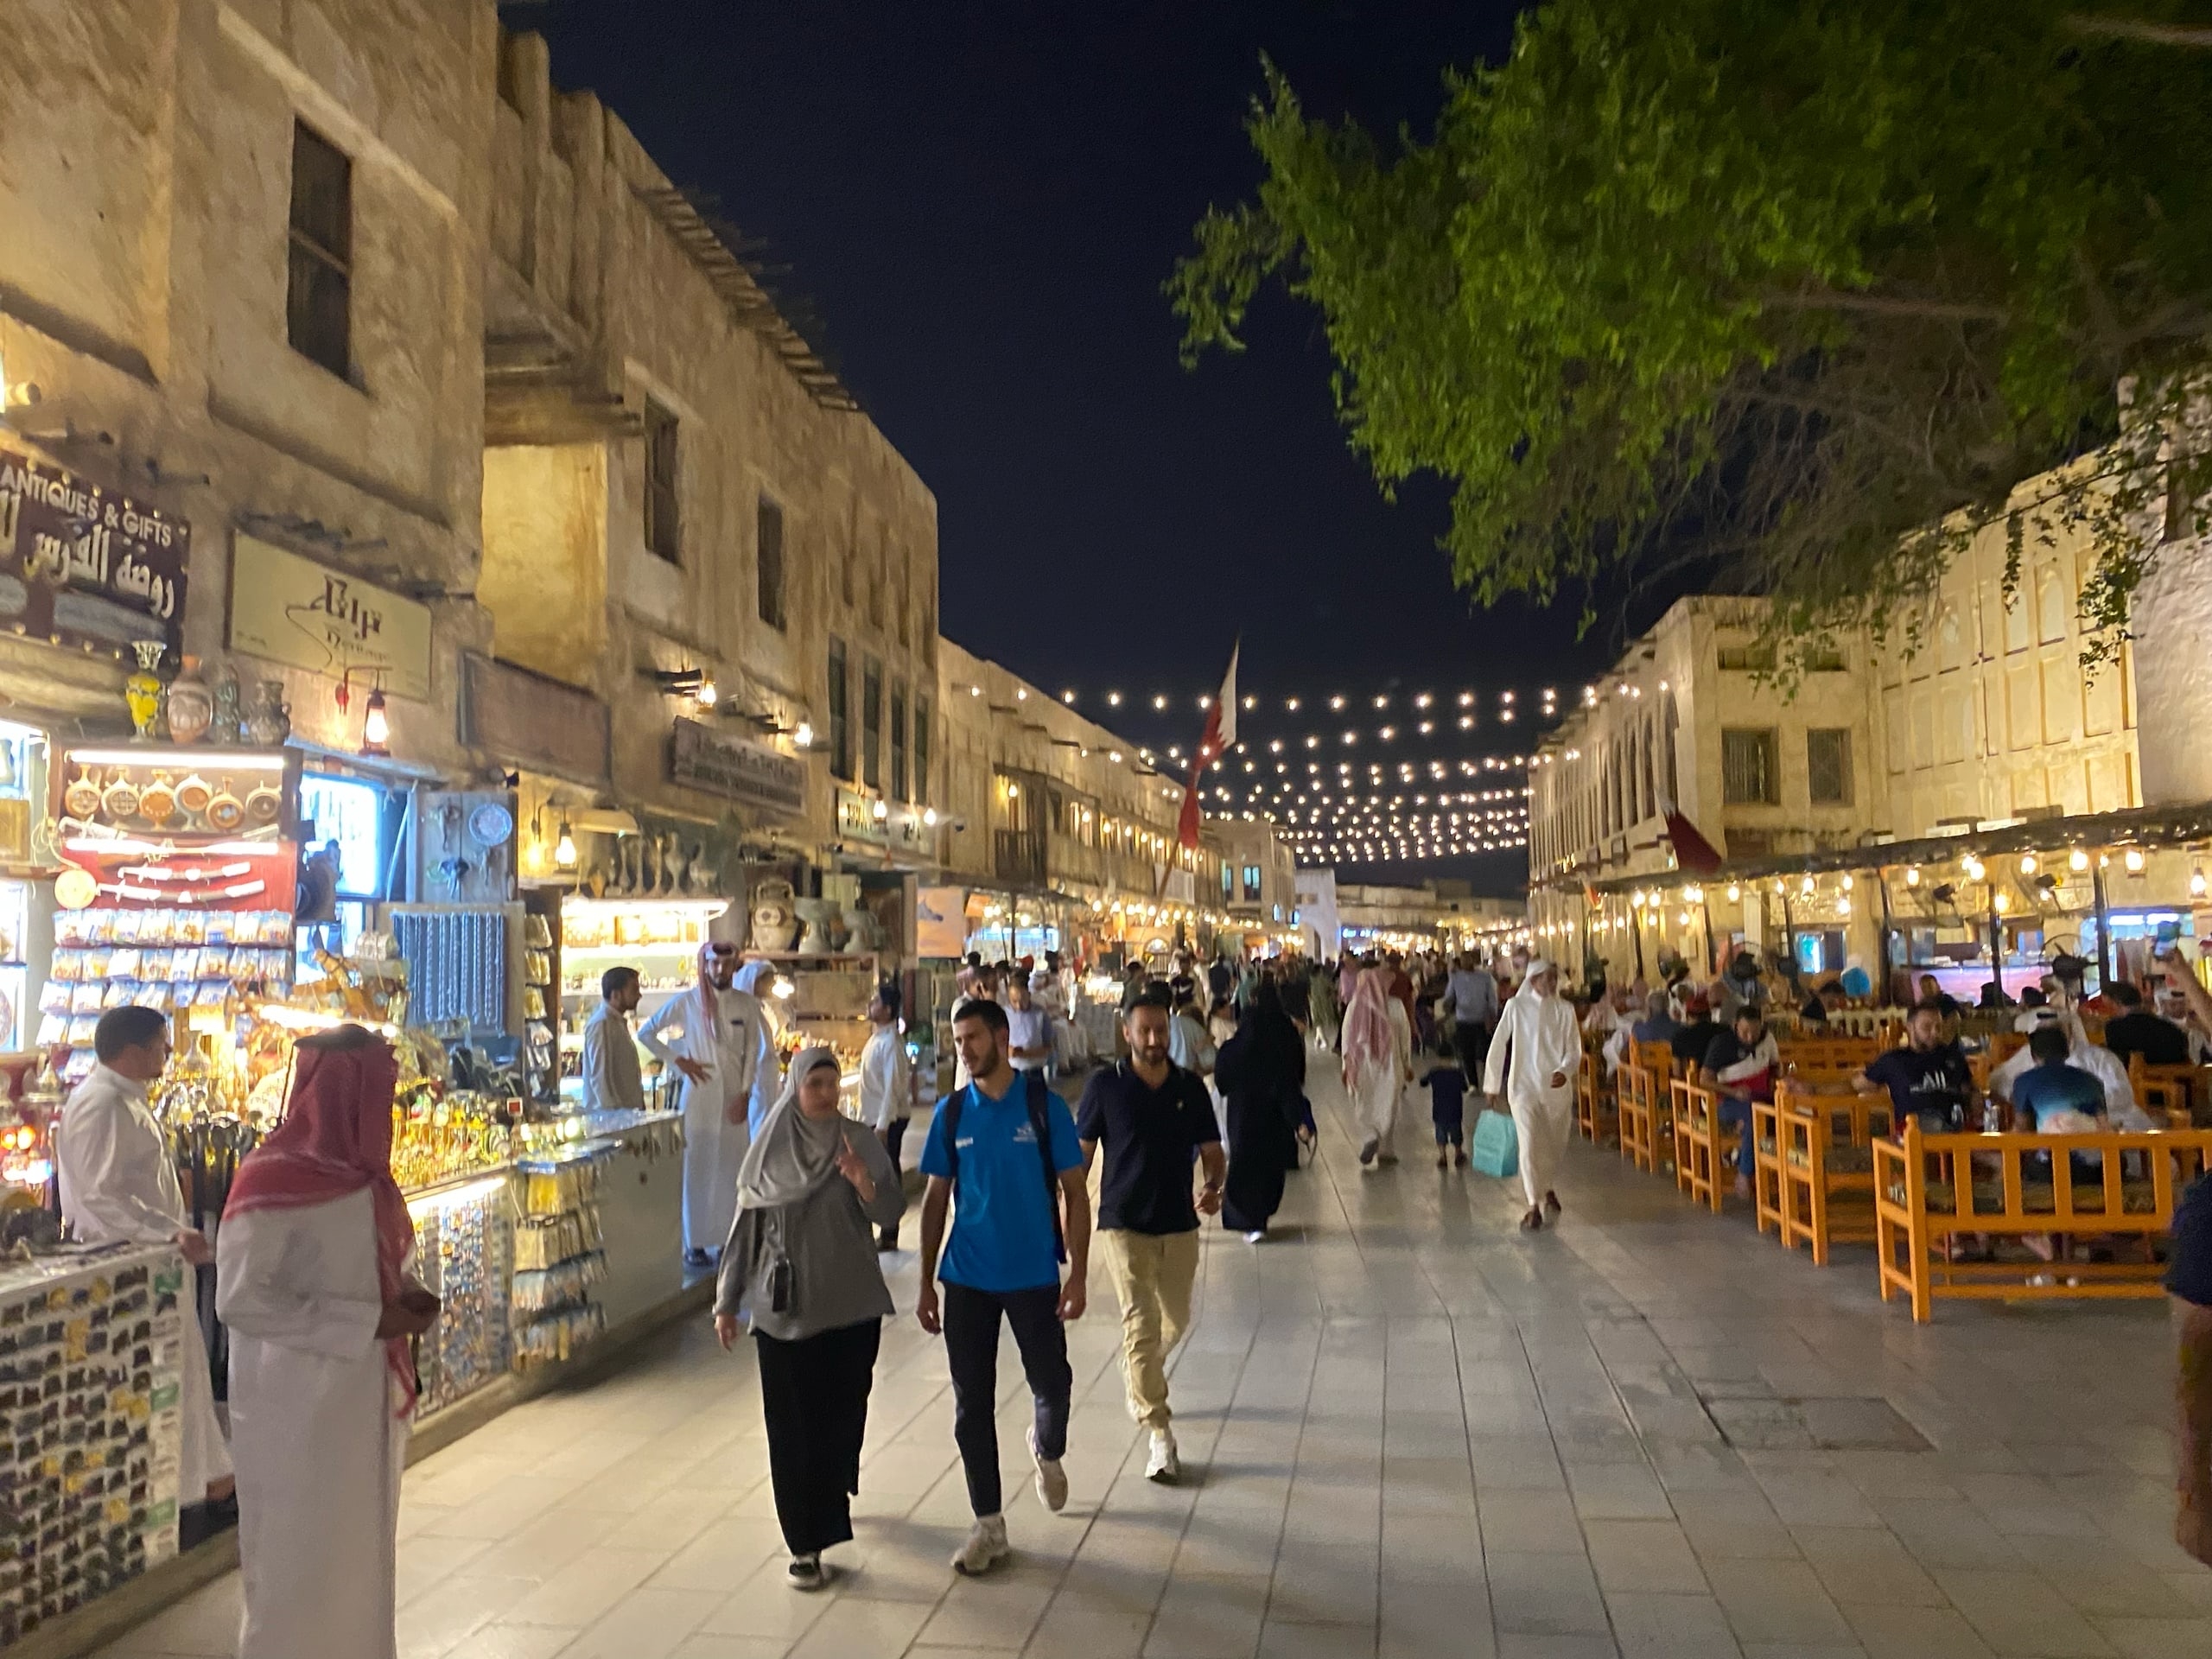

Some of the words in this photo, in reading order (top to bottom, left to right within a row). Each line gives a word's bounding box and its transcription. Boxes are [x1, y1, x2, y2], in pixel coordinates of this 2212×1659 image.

[2, 464, 99, 519] ANTIQUES
[105, 503, 119, 529] &
[123, 510, 172, 547] GIFTS
[116, 537, 175, 619] روضة
